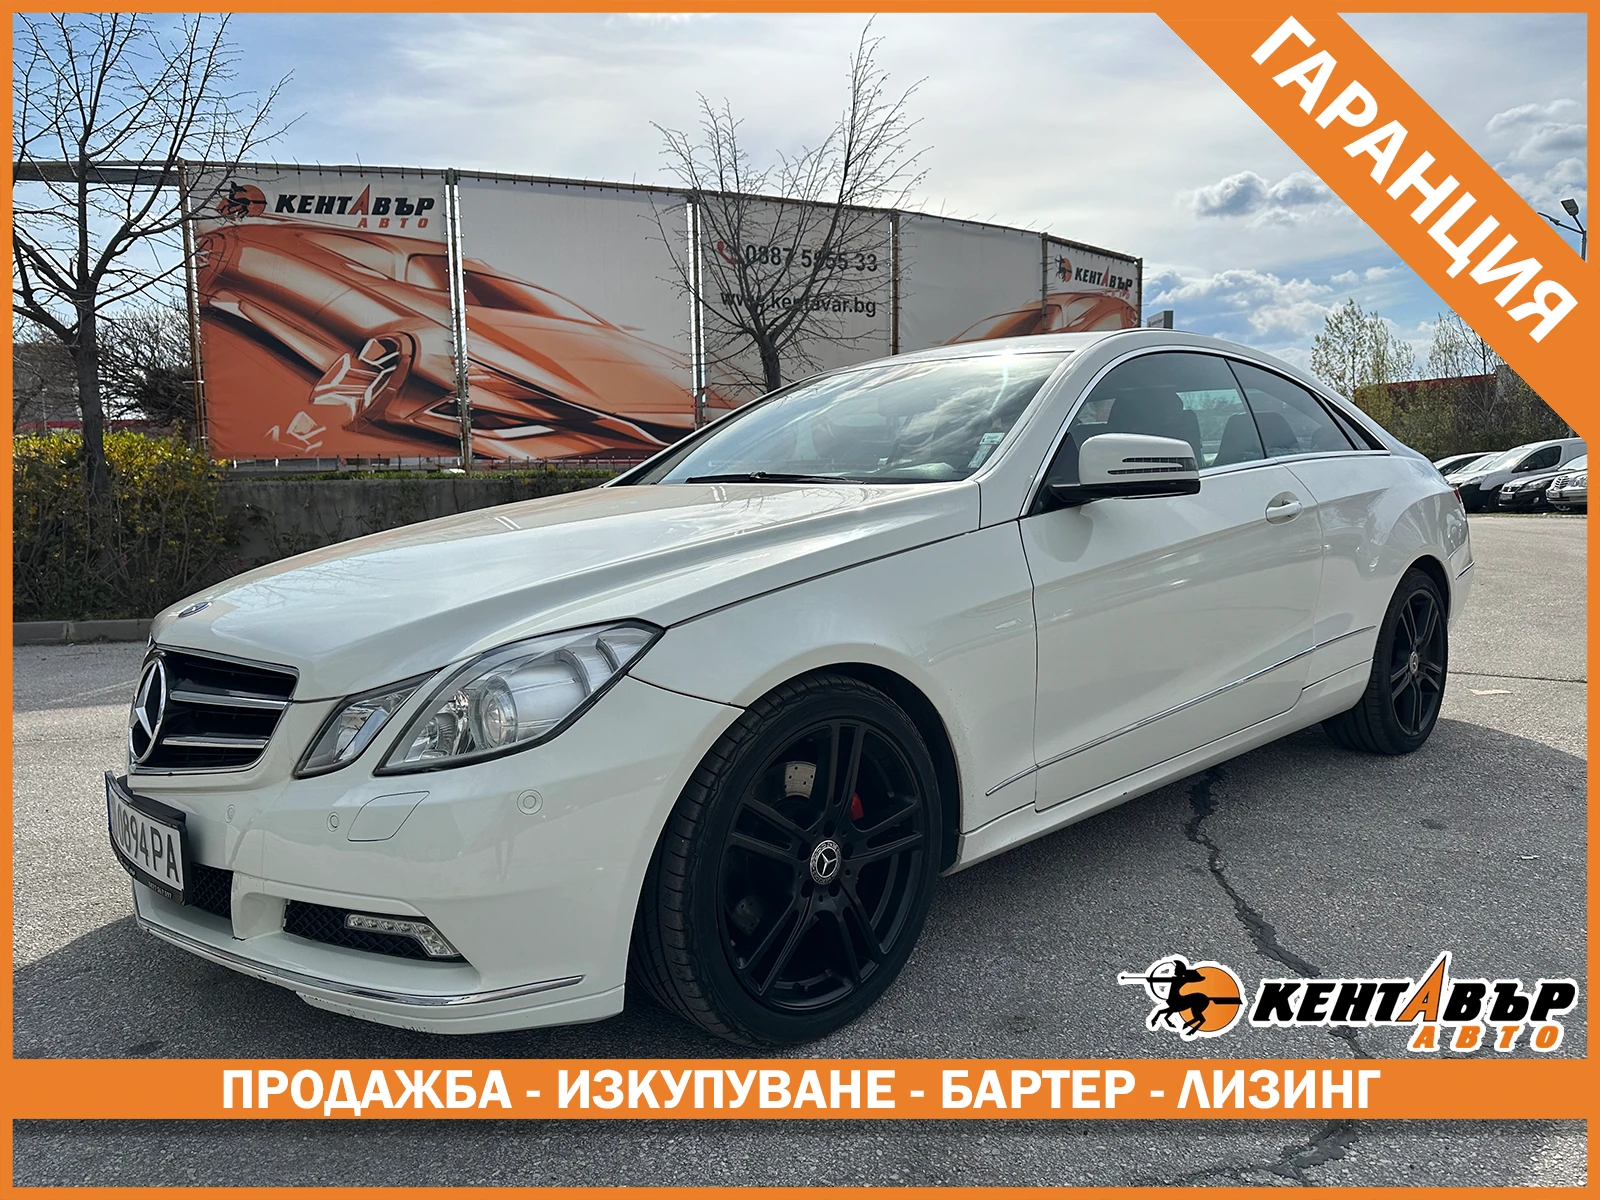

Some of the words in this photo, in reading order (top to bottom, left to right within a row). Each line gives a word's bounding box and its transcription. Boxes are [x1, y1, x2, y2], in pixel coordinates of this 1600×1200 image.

[274, 183, 435, 216] КЕНТАВЪР
[357, 217, 429, 229] АВТО
[855, 252, 877, 272] 33
[1074, 265, 1133, 291] КЕНТАВЪР
